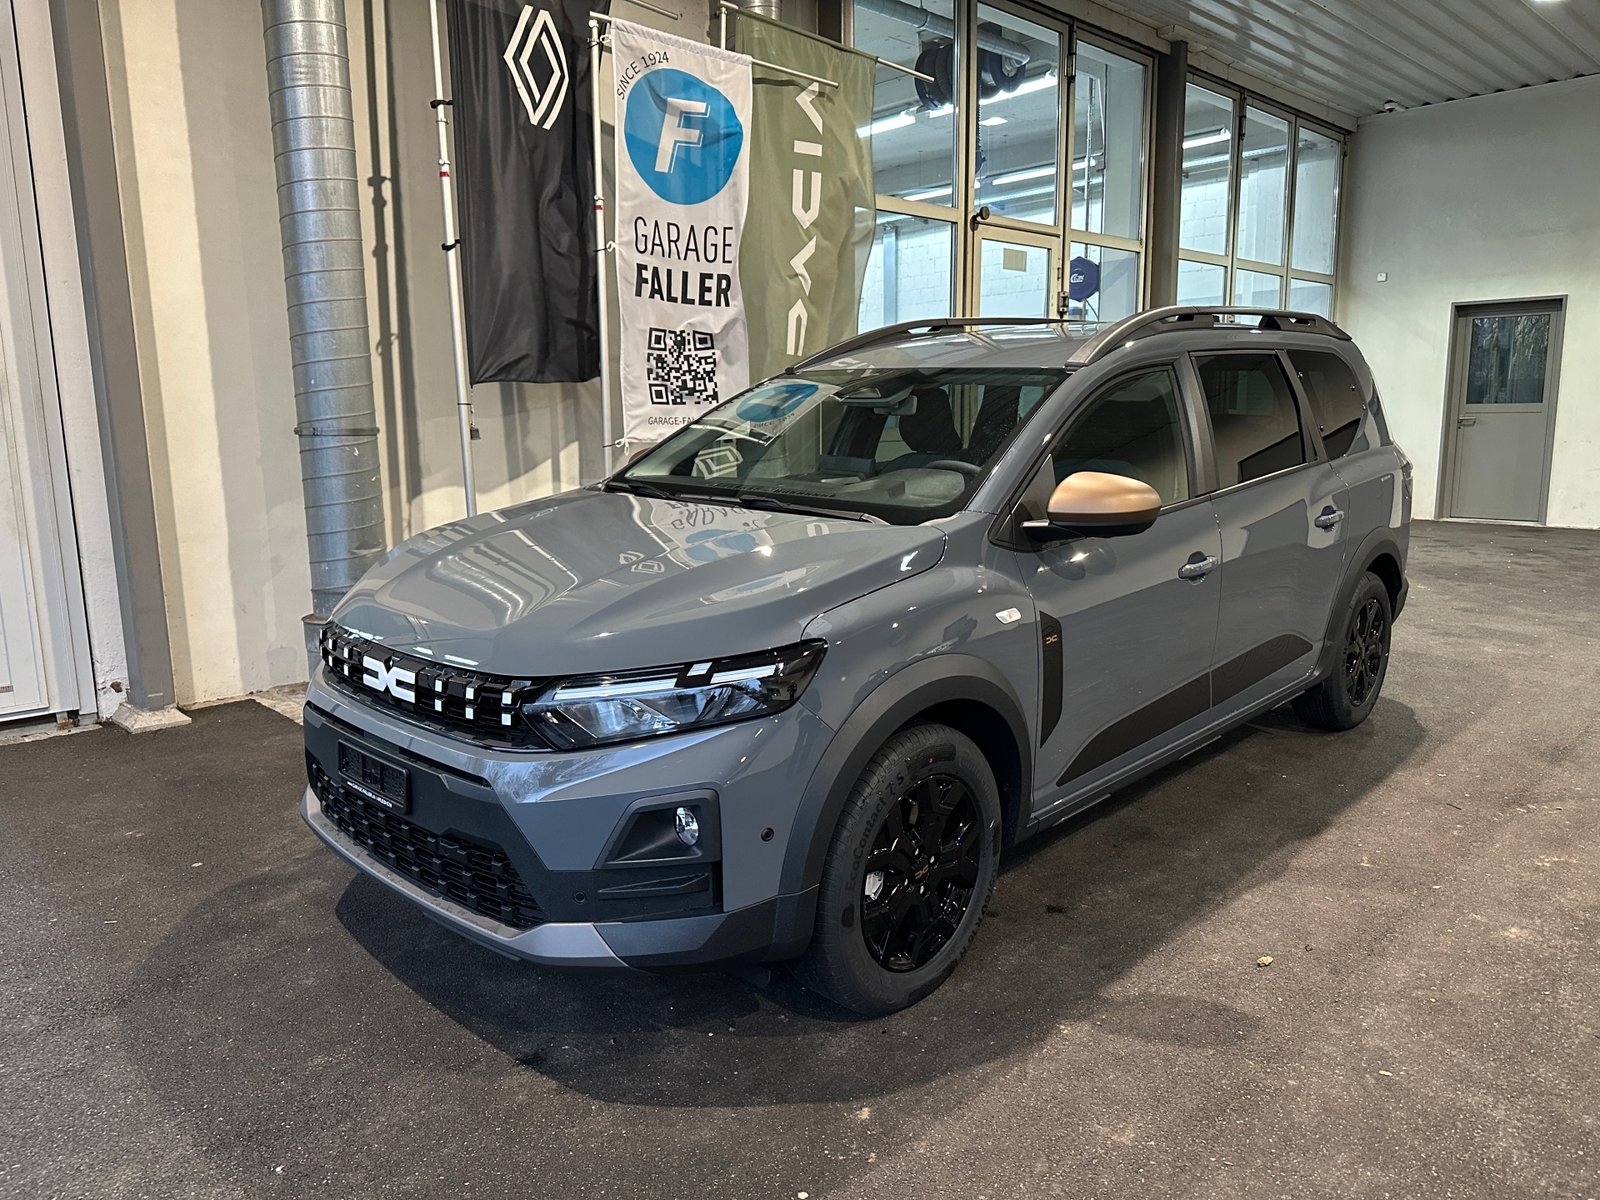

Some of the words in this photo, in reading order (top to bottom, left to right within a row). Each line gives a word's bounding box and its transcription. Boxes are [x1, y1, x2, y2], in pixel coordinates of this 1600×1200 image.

[616, 61, 641, 100] SINCE
[640, 51, 669, 69] 1924
[654, 97, 711, 174] F
[634, 216, 733, 263] GARAGE
[634, 262, 732, 307] FALLER
